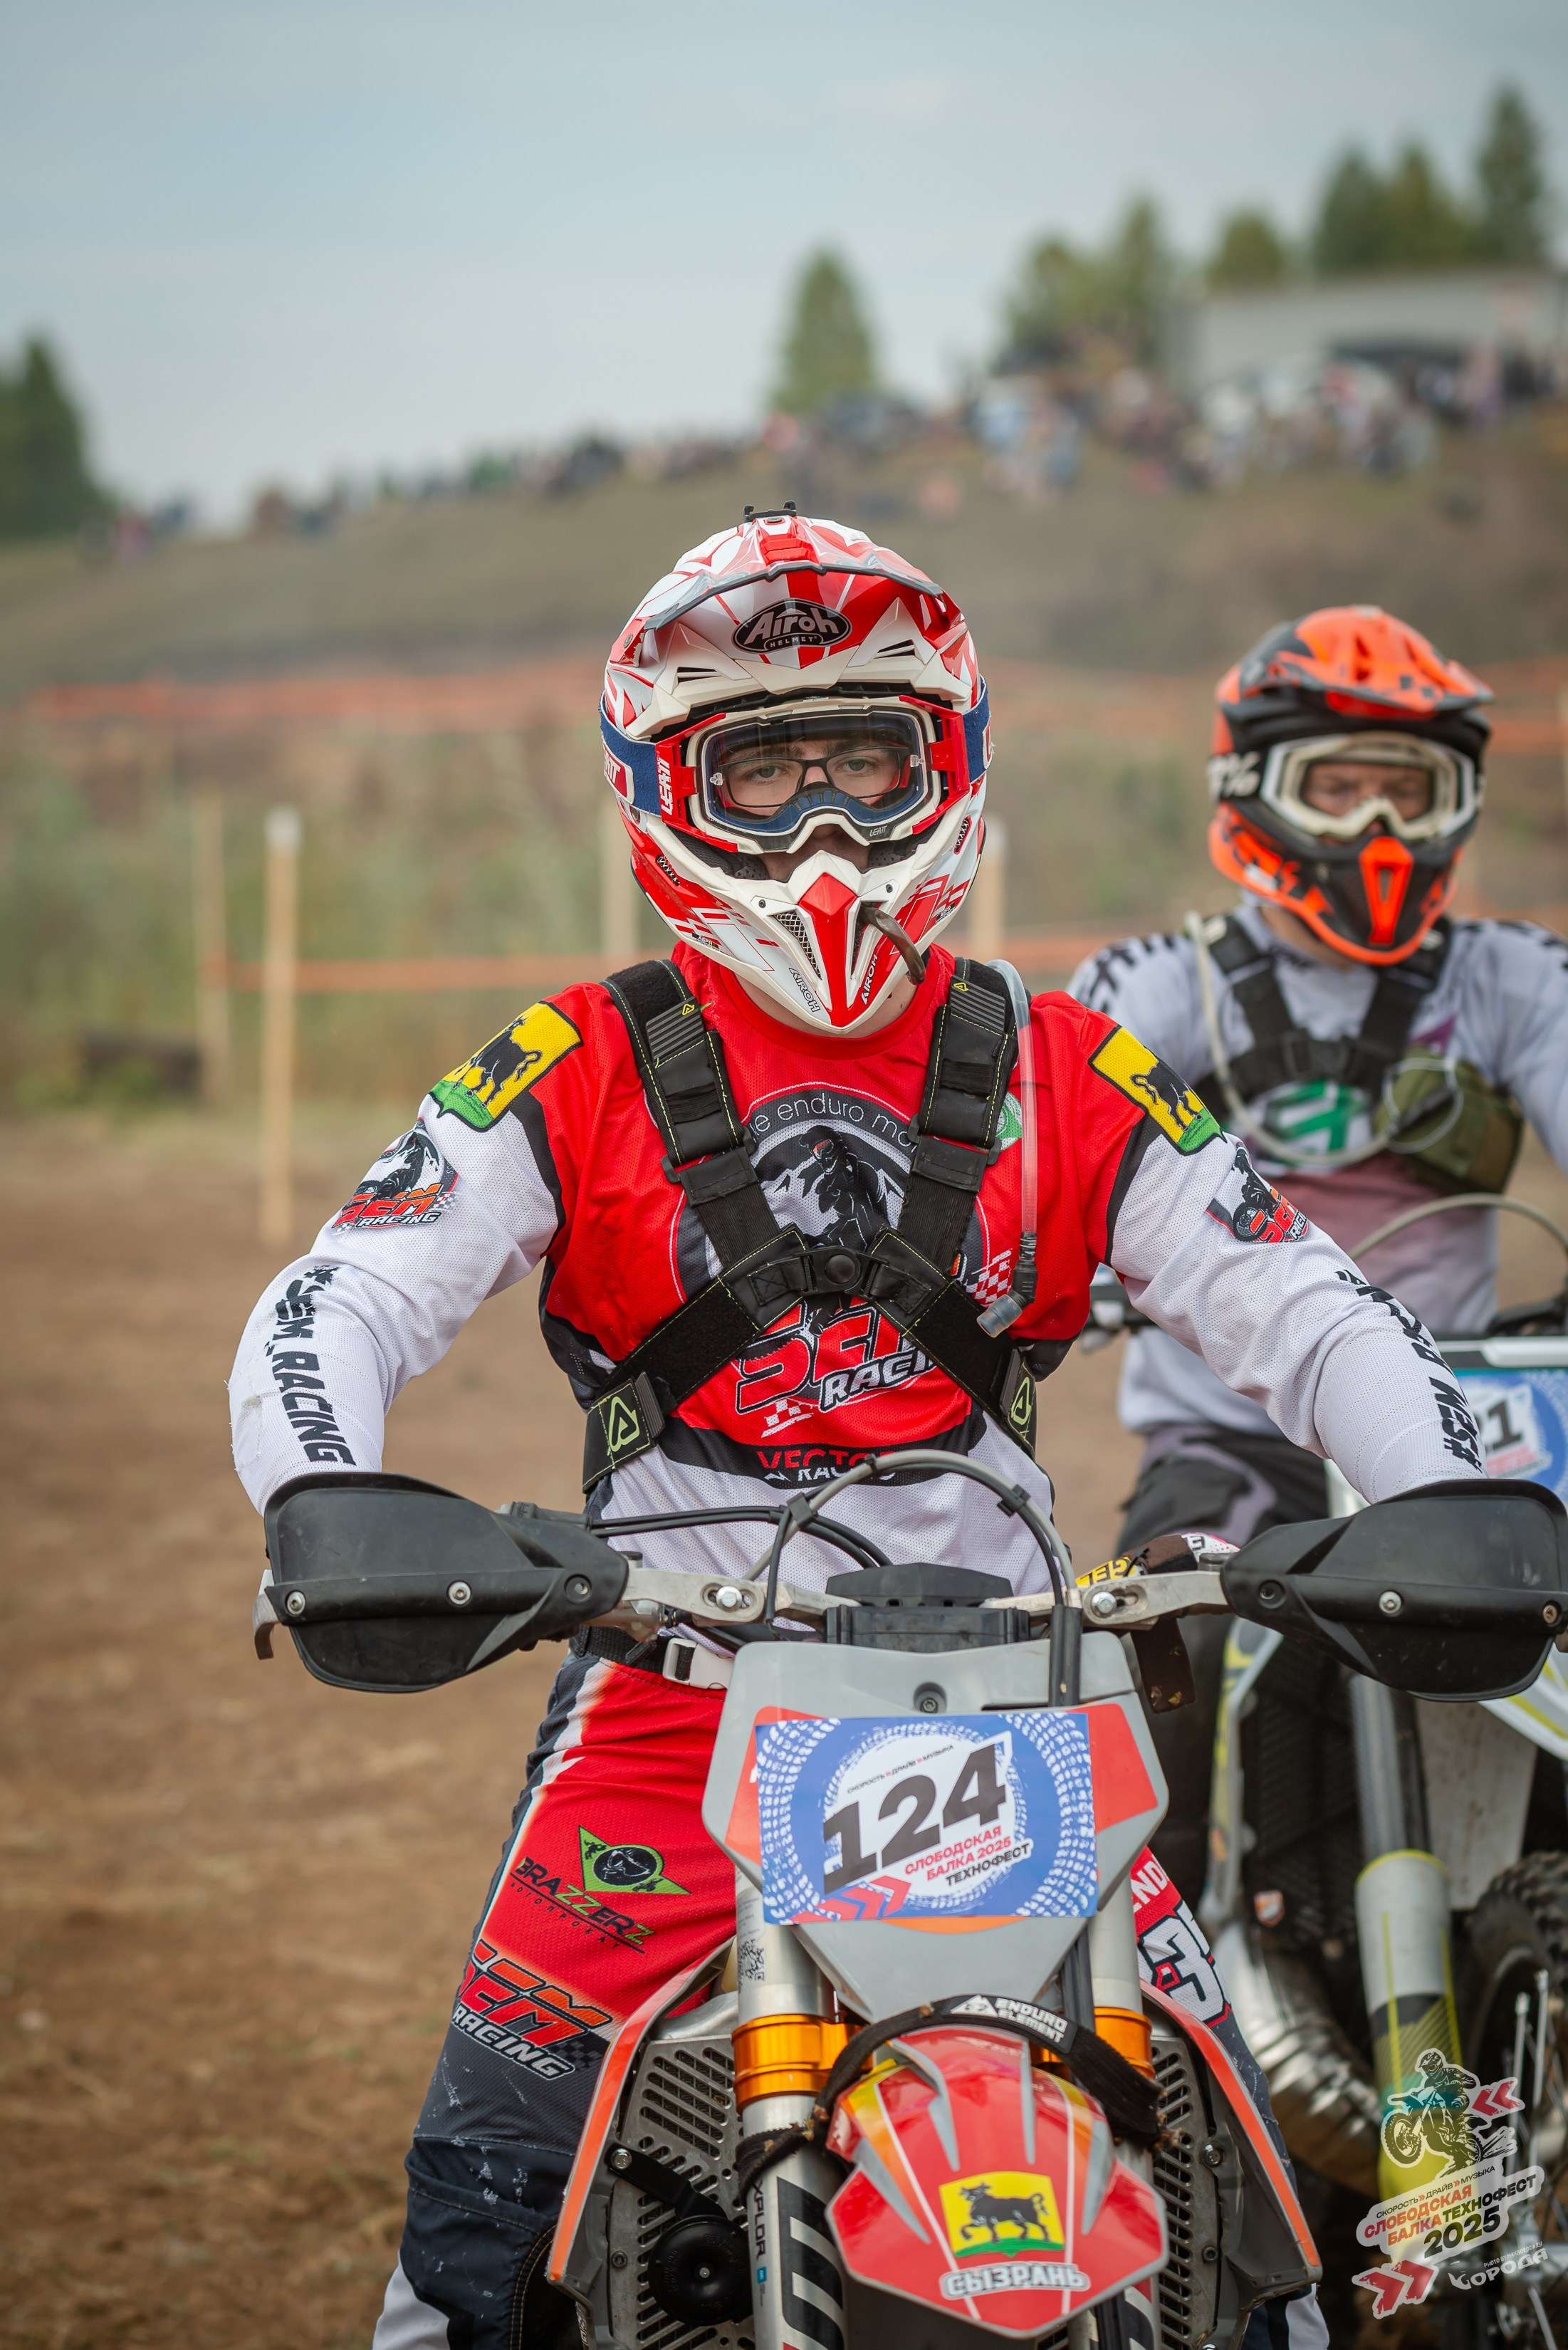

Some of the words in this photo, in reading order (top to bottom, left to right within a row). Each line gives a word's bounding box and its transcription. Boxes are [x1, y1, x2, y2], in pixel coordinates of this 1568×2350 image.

[743, 607, 840, 645] Airoh
[657, 756, 674, 815] LEATT
[869, 825, 888, 837] LEATT
[788, 967, 821, 1013] AIROH
[861, 954, 879, 1006] AIROH
[777, 1092, 864, 1122] enduro
[355, 1211, 442, 1228] RACING
[847, 1774, 885, 1795] СКОРОСТЬ
[892, 1760, 916, 1776] ДРАЙВ
[922, 1744, 954, 1762] МУЗЫКА
[823, 1743, 1007, 1896] 124
[904, 1825, 1002, 1875] СЛОБОДСКАЯ
[926, 1852, 976, 1881] БАЛКА
[977, 1836, 1012, 1860] 2025
[946, 1842, 1030, 1886] ТЕХНОФЕСТ
[514, 1856, 656, 1946] BRAZZERZ
[995, 1998, 1068, 2033] ENDURO
[997, 2008, 1064, 2043] ELEMENT
[451, 2002, 575, 2080] RACING
[945, 2263, 1086, 2297] СЫЗРАНЬ
